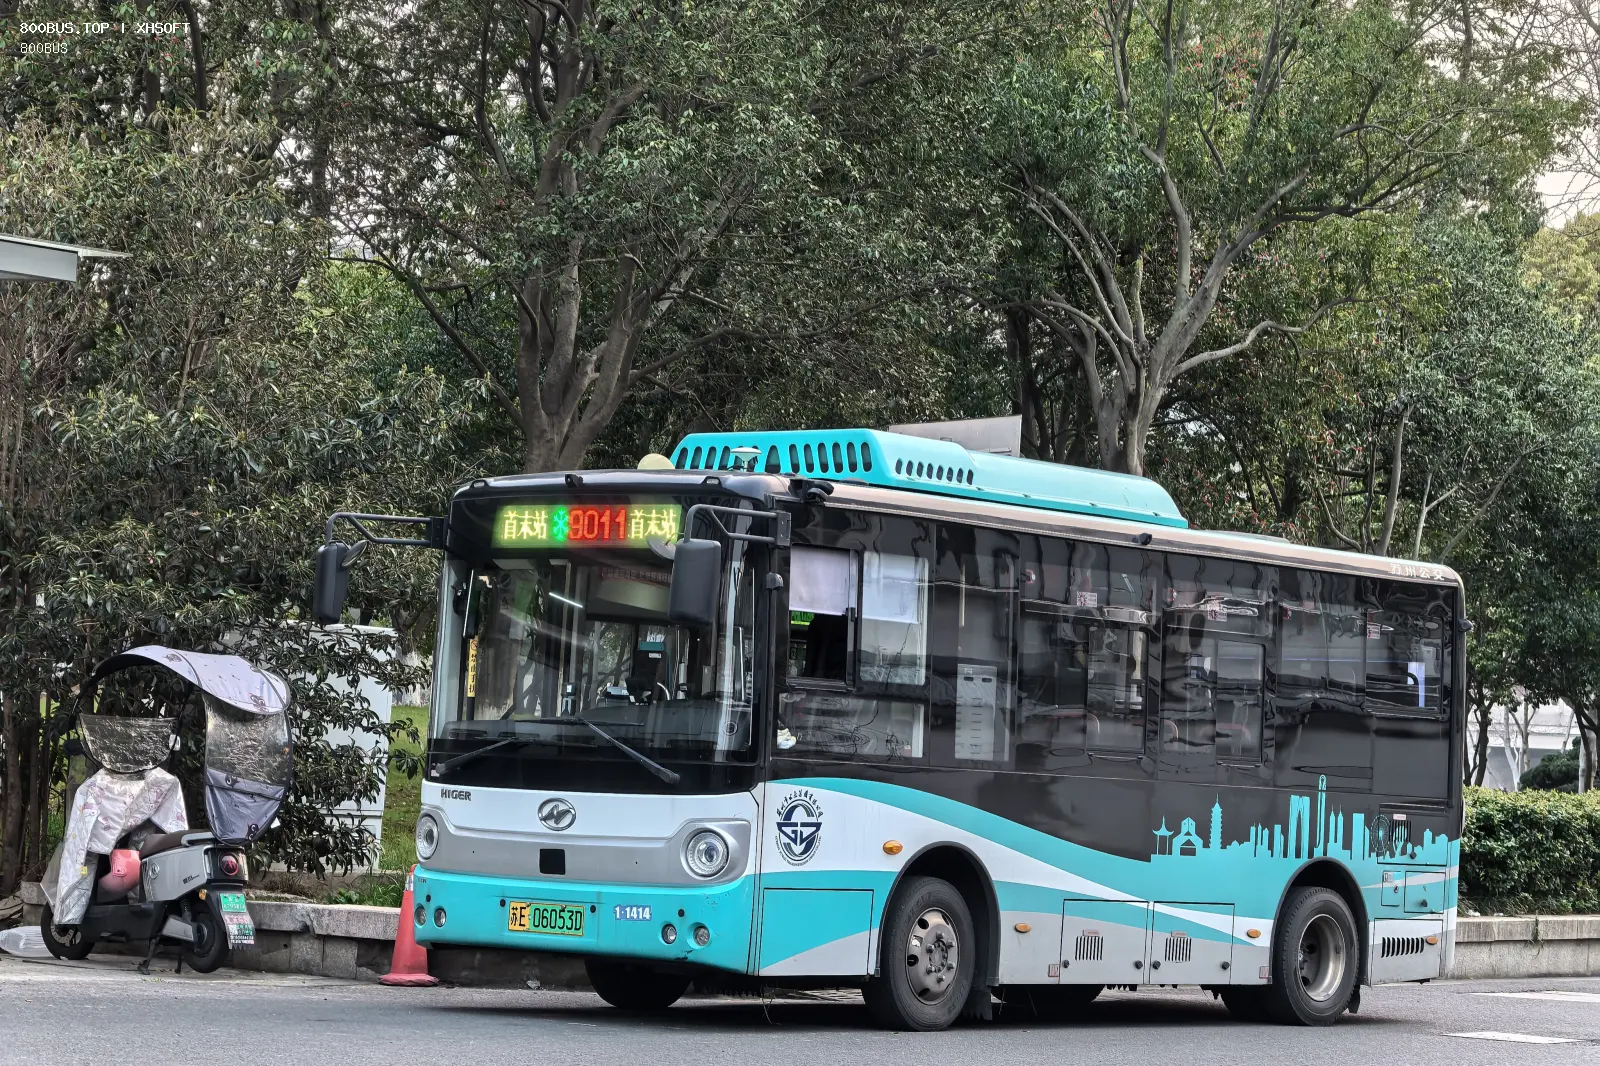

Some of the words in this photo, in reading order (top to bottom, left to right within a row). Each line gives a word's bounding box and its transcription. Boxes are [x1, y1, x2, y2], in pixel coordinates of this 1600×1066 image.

[503, 510, 548, 539] 首末站
[568, 509, 626, 539] 9011
[630, 509, 677, 539] 首末站
[440, 788, 472, 801] HIGER
